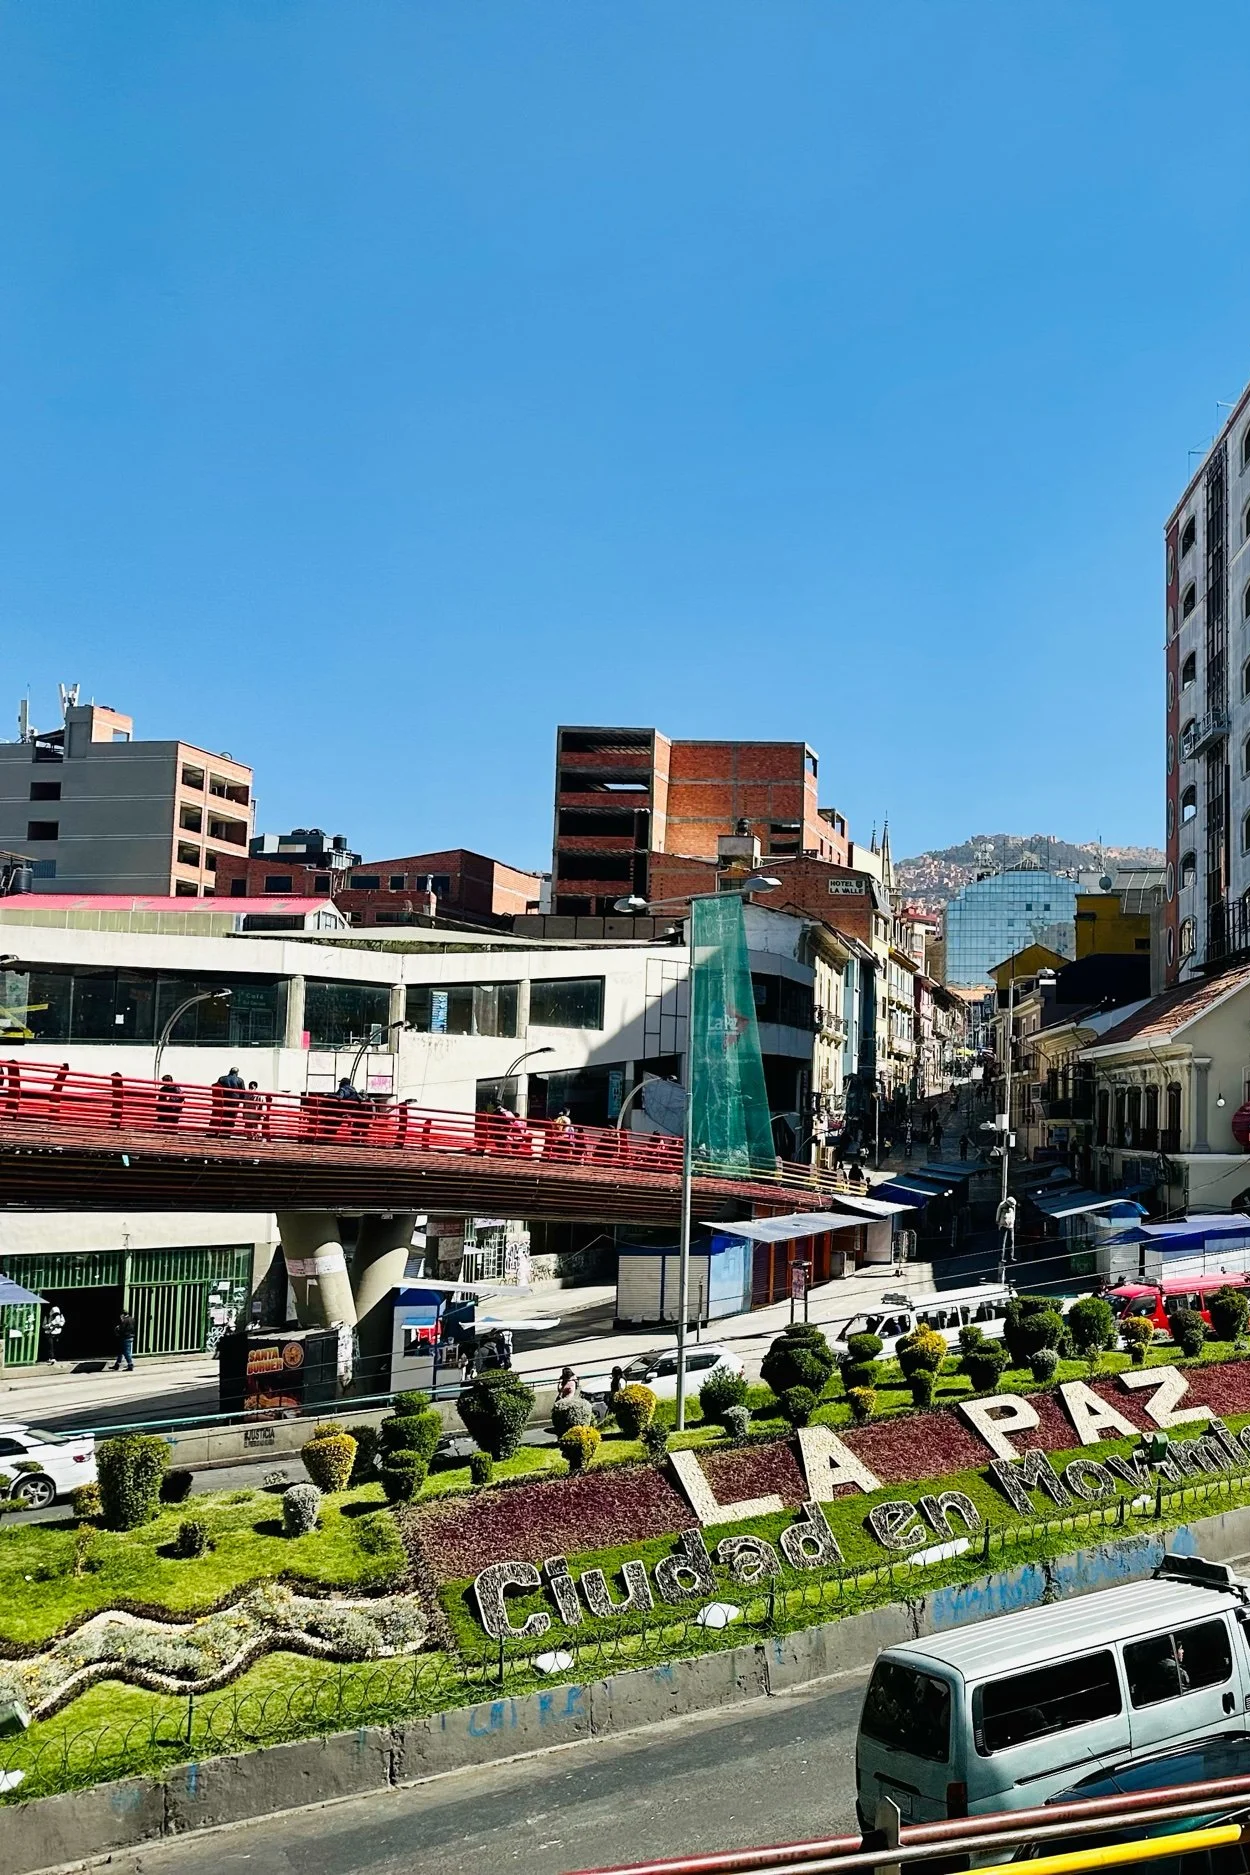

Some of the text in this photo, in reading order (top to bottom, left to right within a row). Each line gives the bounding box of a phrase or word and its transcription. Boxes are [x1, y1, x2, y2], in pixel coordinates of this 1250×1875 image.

[246, 1358, 284, 1375] BURGER
[248, 1346, 279, 1362] SANTA
[669, 1365, 1217, 1526] LA PAZ
[473, 1499, 845, 1640] Ciudad
[868, 1488, 983, 1551] en
